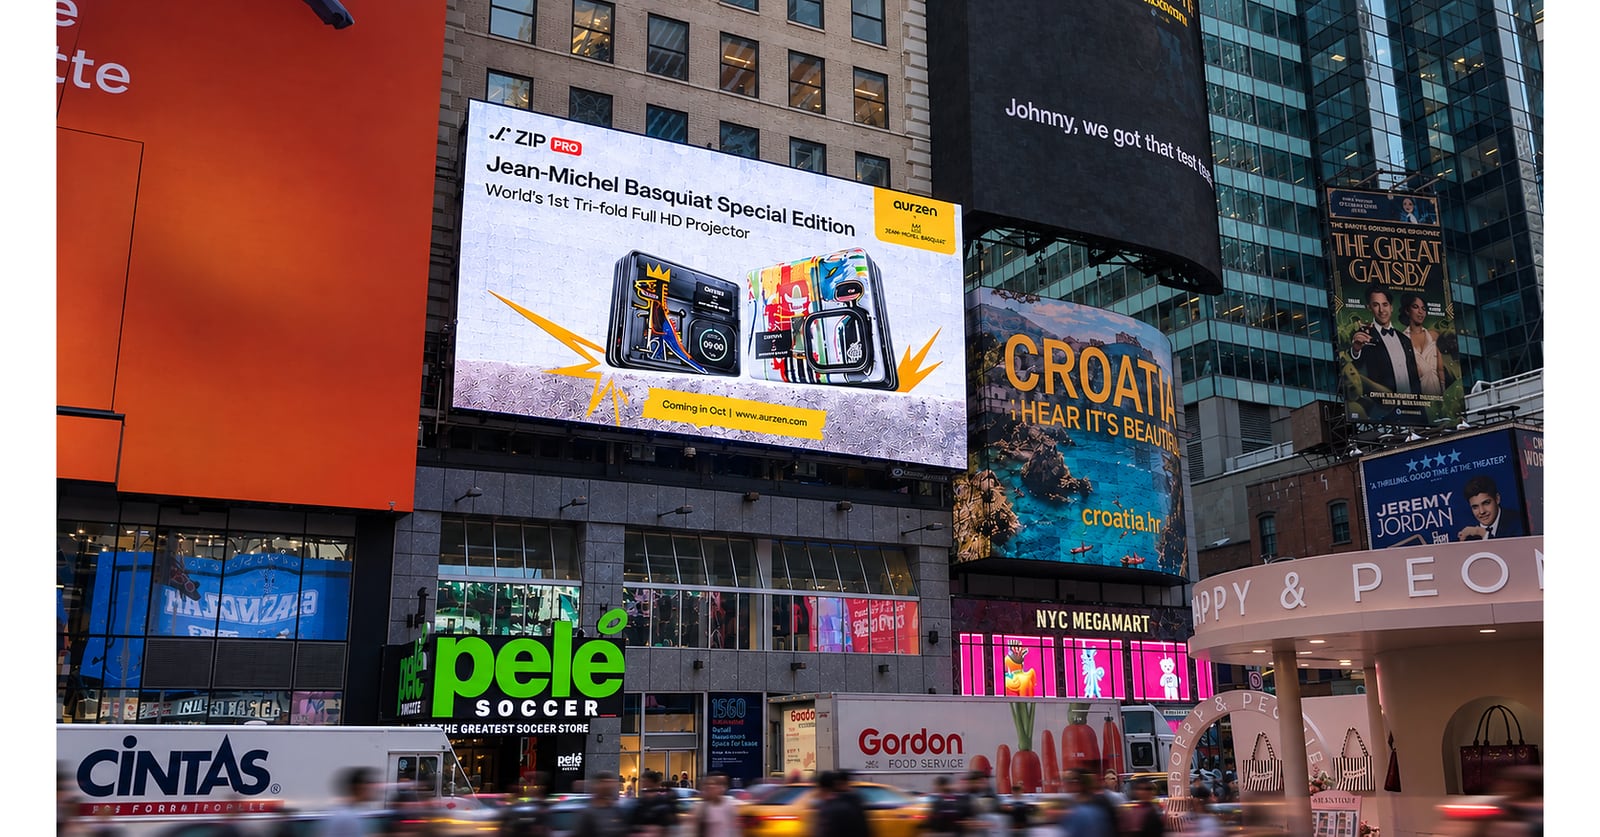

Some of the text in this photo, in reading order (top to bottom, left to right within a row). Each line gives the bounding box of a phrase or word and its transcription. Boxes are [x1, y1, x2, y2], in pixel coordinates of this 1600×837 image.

[515, 130, 579, 153] ZIP PRO
[1005, 98, 1078, 135] Johnny,
[1082, 120, 1109, 139] we
[1113, 128, 1141, 148] got
[1145, 134, 1174, 159] that
[1176, 146, 1197, 171] test
[486, 156, 856, 237] Jean-Michel Basquiat Special Edition
[893, 200, 938, 216] aurzen
[485, 183, 750, 239] World's 1st Tri-fold Full HD Projector
[1332, 232, 1442, 264] THE GREAT
[1348, 258, 1432, 287] GATSBY
[1004, 333, 1177, 430] CROATIA
[662, 400, 808, 427] Coming in Oct www.aurzen.com
[1021, 399, 1081, 430] HEAR
[1086, 408, 1119, 436] IT'S
[1432, 468, 1449, 477] TIME
[1459, 462, 1472, 472] THE
[1376, 491, 1453, 517] JEREMY
[1081, 508, 1162, 534] croatia.hr
[1376, 507, 1454, 538] JORDAN
[1280, 571, 1307, 609] &
[1036, 609, 1150, 633] NYC MEGAMART
[432, 608, 628, 717] pelé
[475, 699, 598, 717] SOCCER
[712, 698, 746, 718] 1560
[460, 723, 515, 734] GREATEST
[516, 724, 557, 734] SOCCER
[558, 723, 589, 733] STORE
[858, 728, 963, 755] Gordon
[888, 759, 917, 768] FOOD
[920, 759, 964, 768] SERVICE
